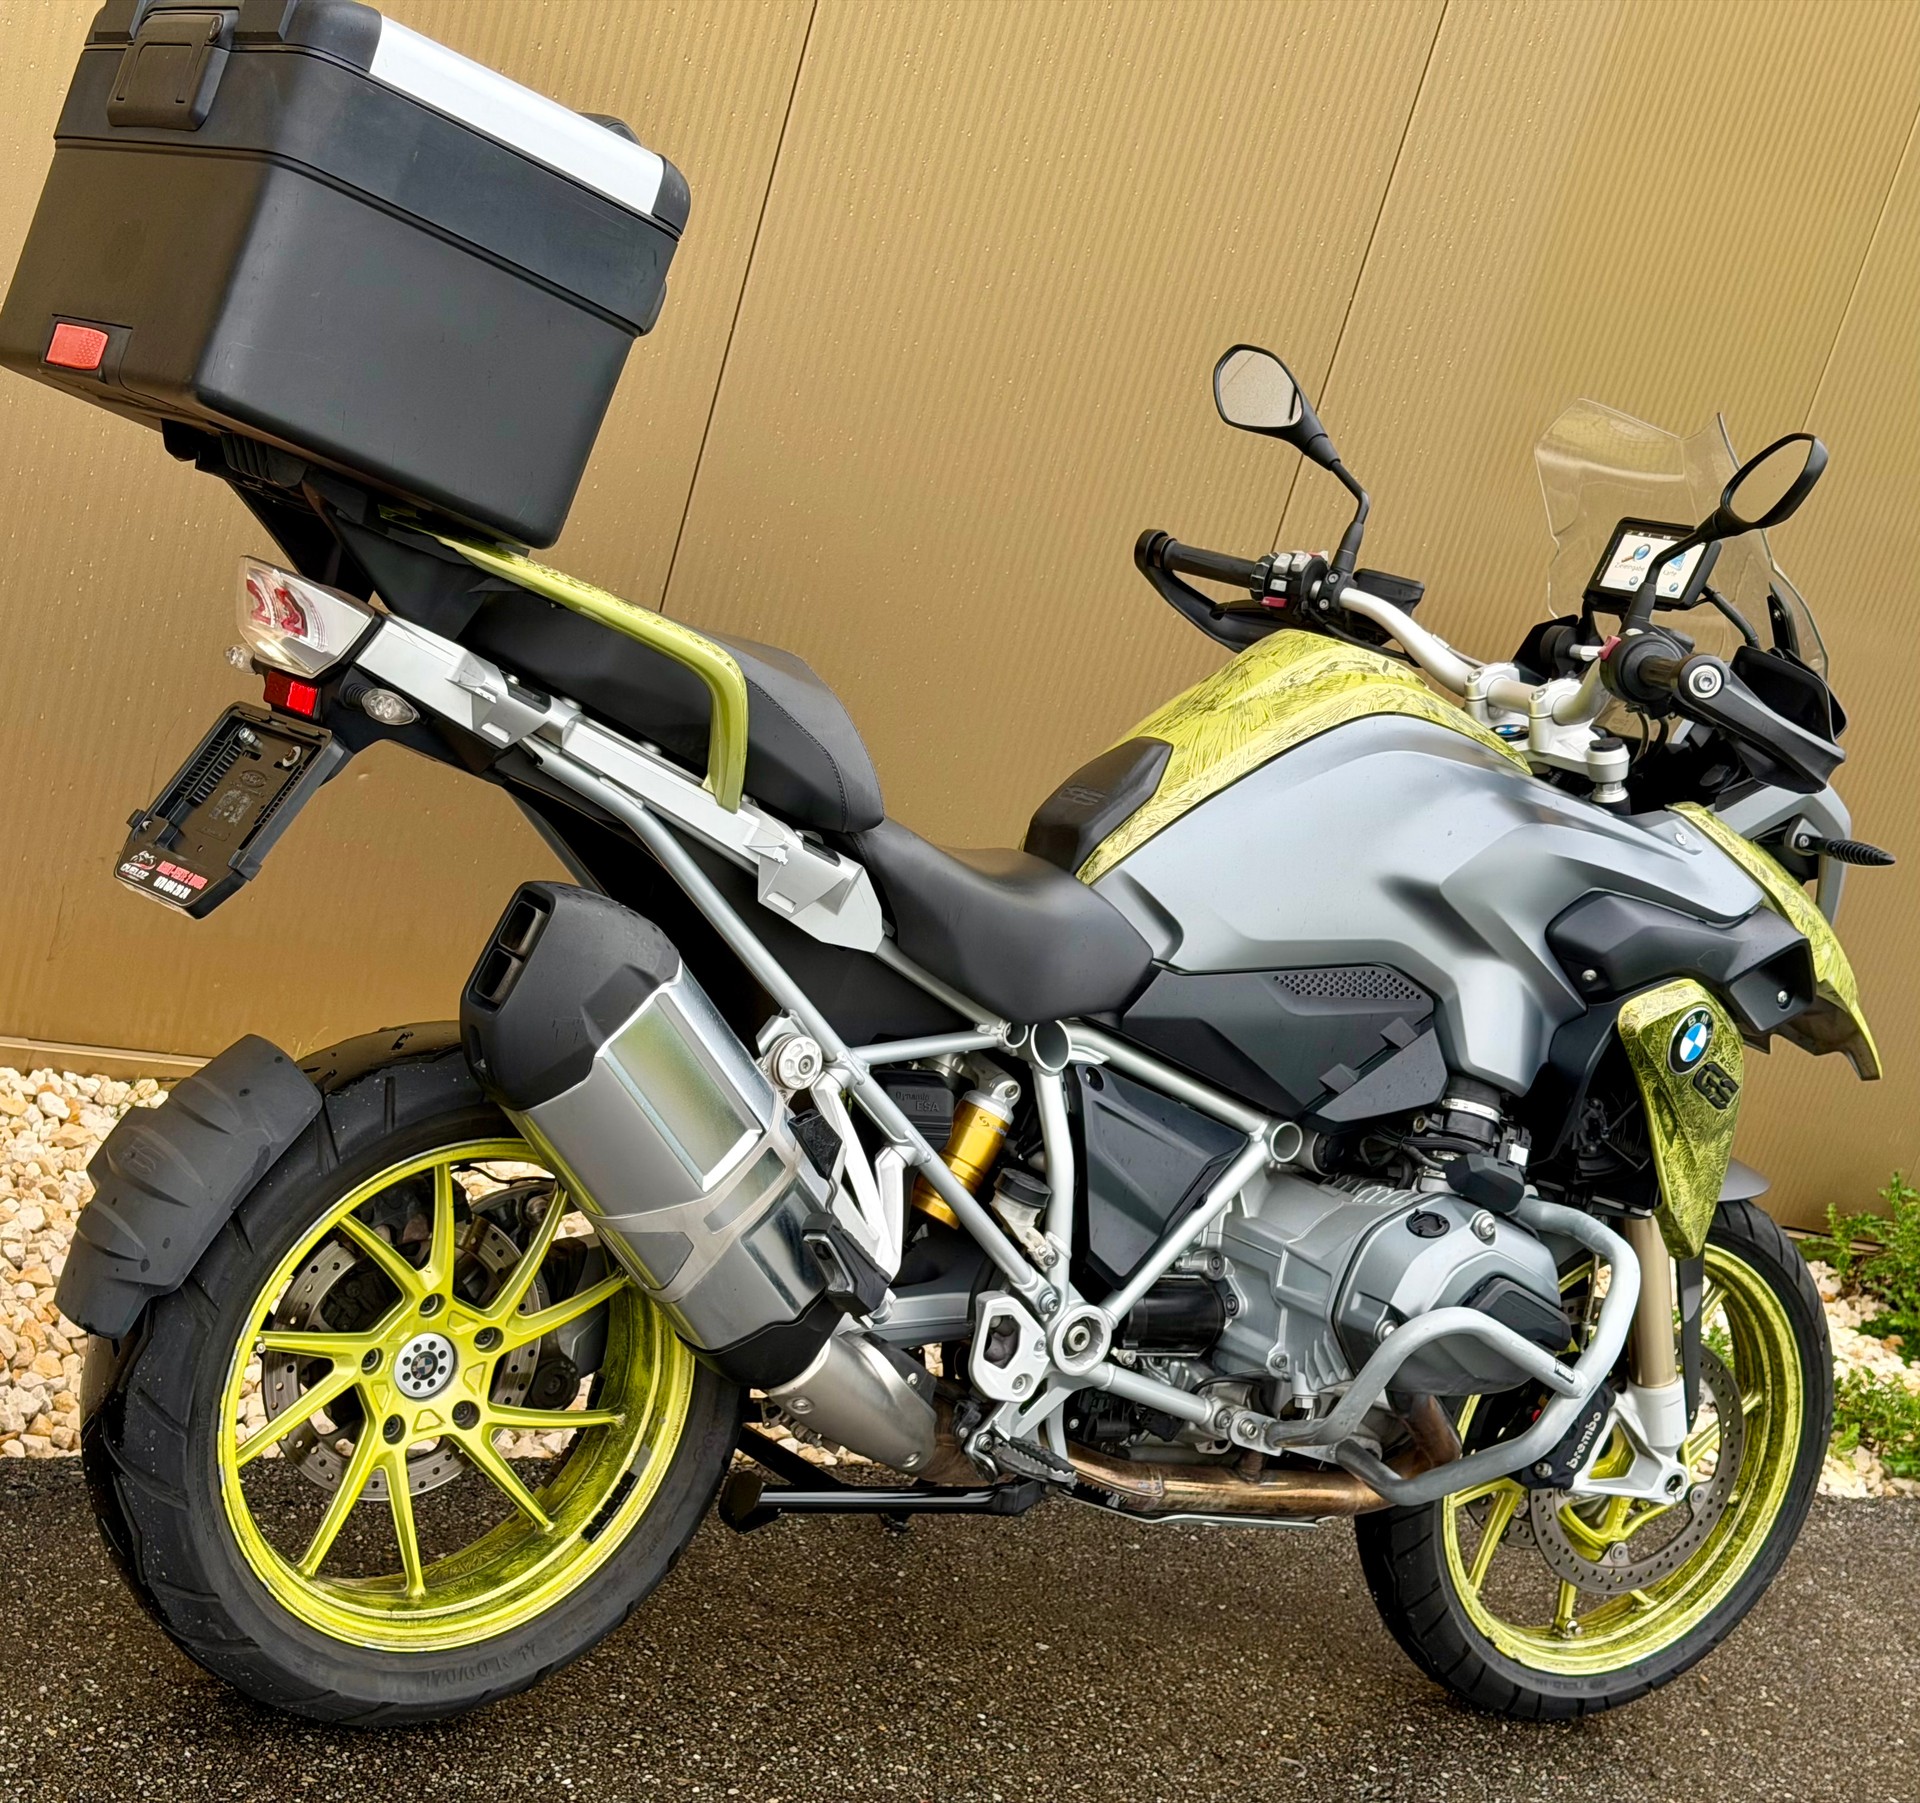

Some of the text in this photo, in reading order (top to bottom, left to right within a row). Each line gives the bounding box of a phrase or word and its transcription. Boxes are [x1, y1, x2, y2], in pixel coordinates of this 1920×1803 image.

[1687, 1012, 1713, 1039] BMW
[1693, 1061, 1740, 1111] GS
[915, 1101, 940, 1113] ESA
[1566, 1411, 1602, 1470] brembo
